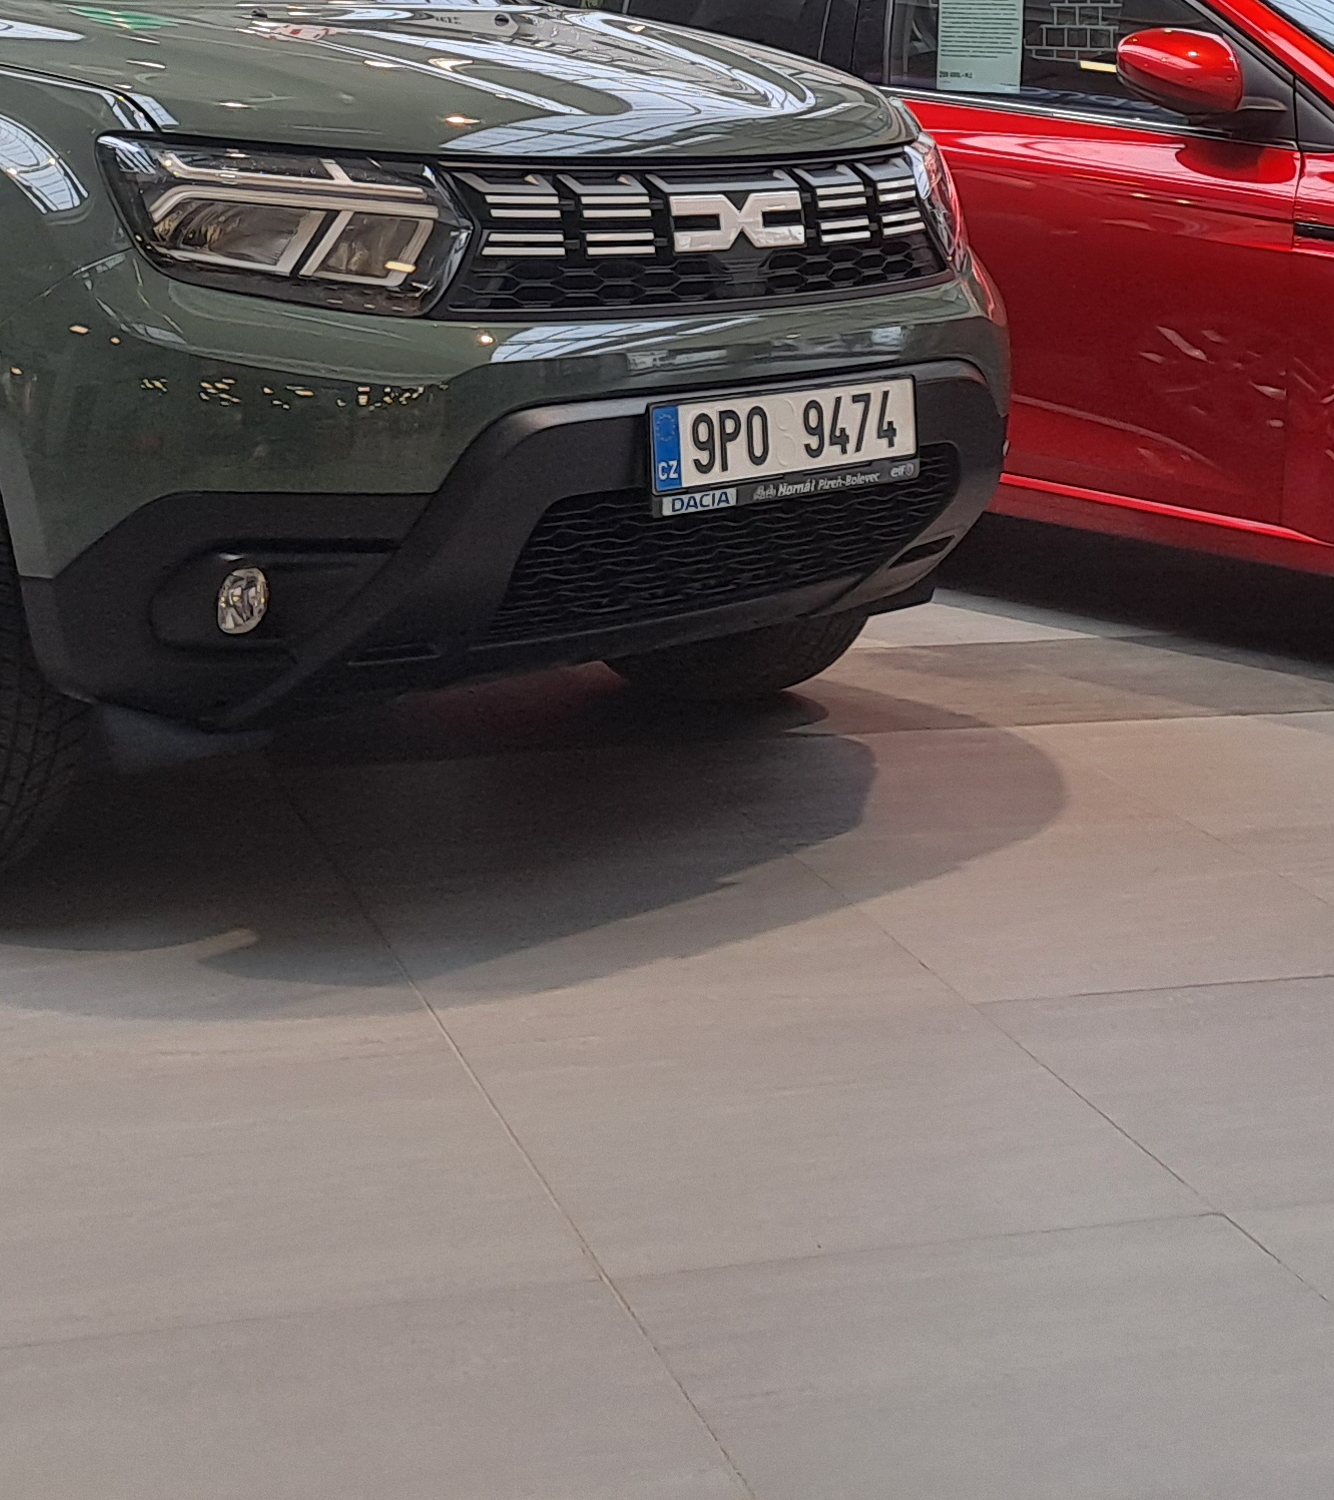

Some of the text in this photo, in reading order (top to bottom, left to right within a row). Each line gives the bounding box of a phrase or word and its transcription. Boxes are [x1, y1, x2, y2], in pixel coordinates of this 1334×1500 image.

[658, 460, 679, 480] CZ
[803, 390, 897, 459] 9474
[671, 491, 730, 513] DACIA
